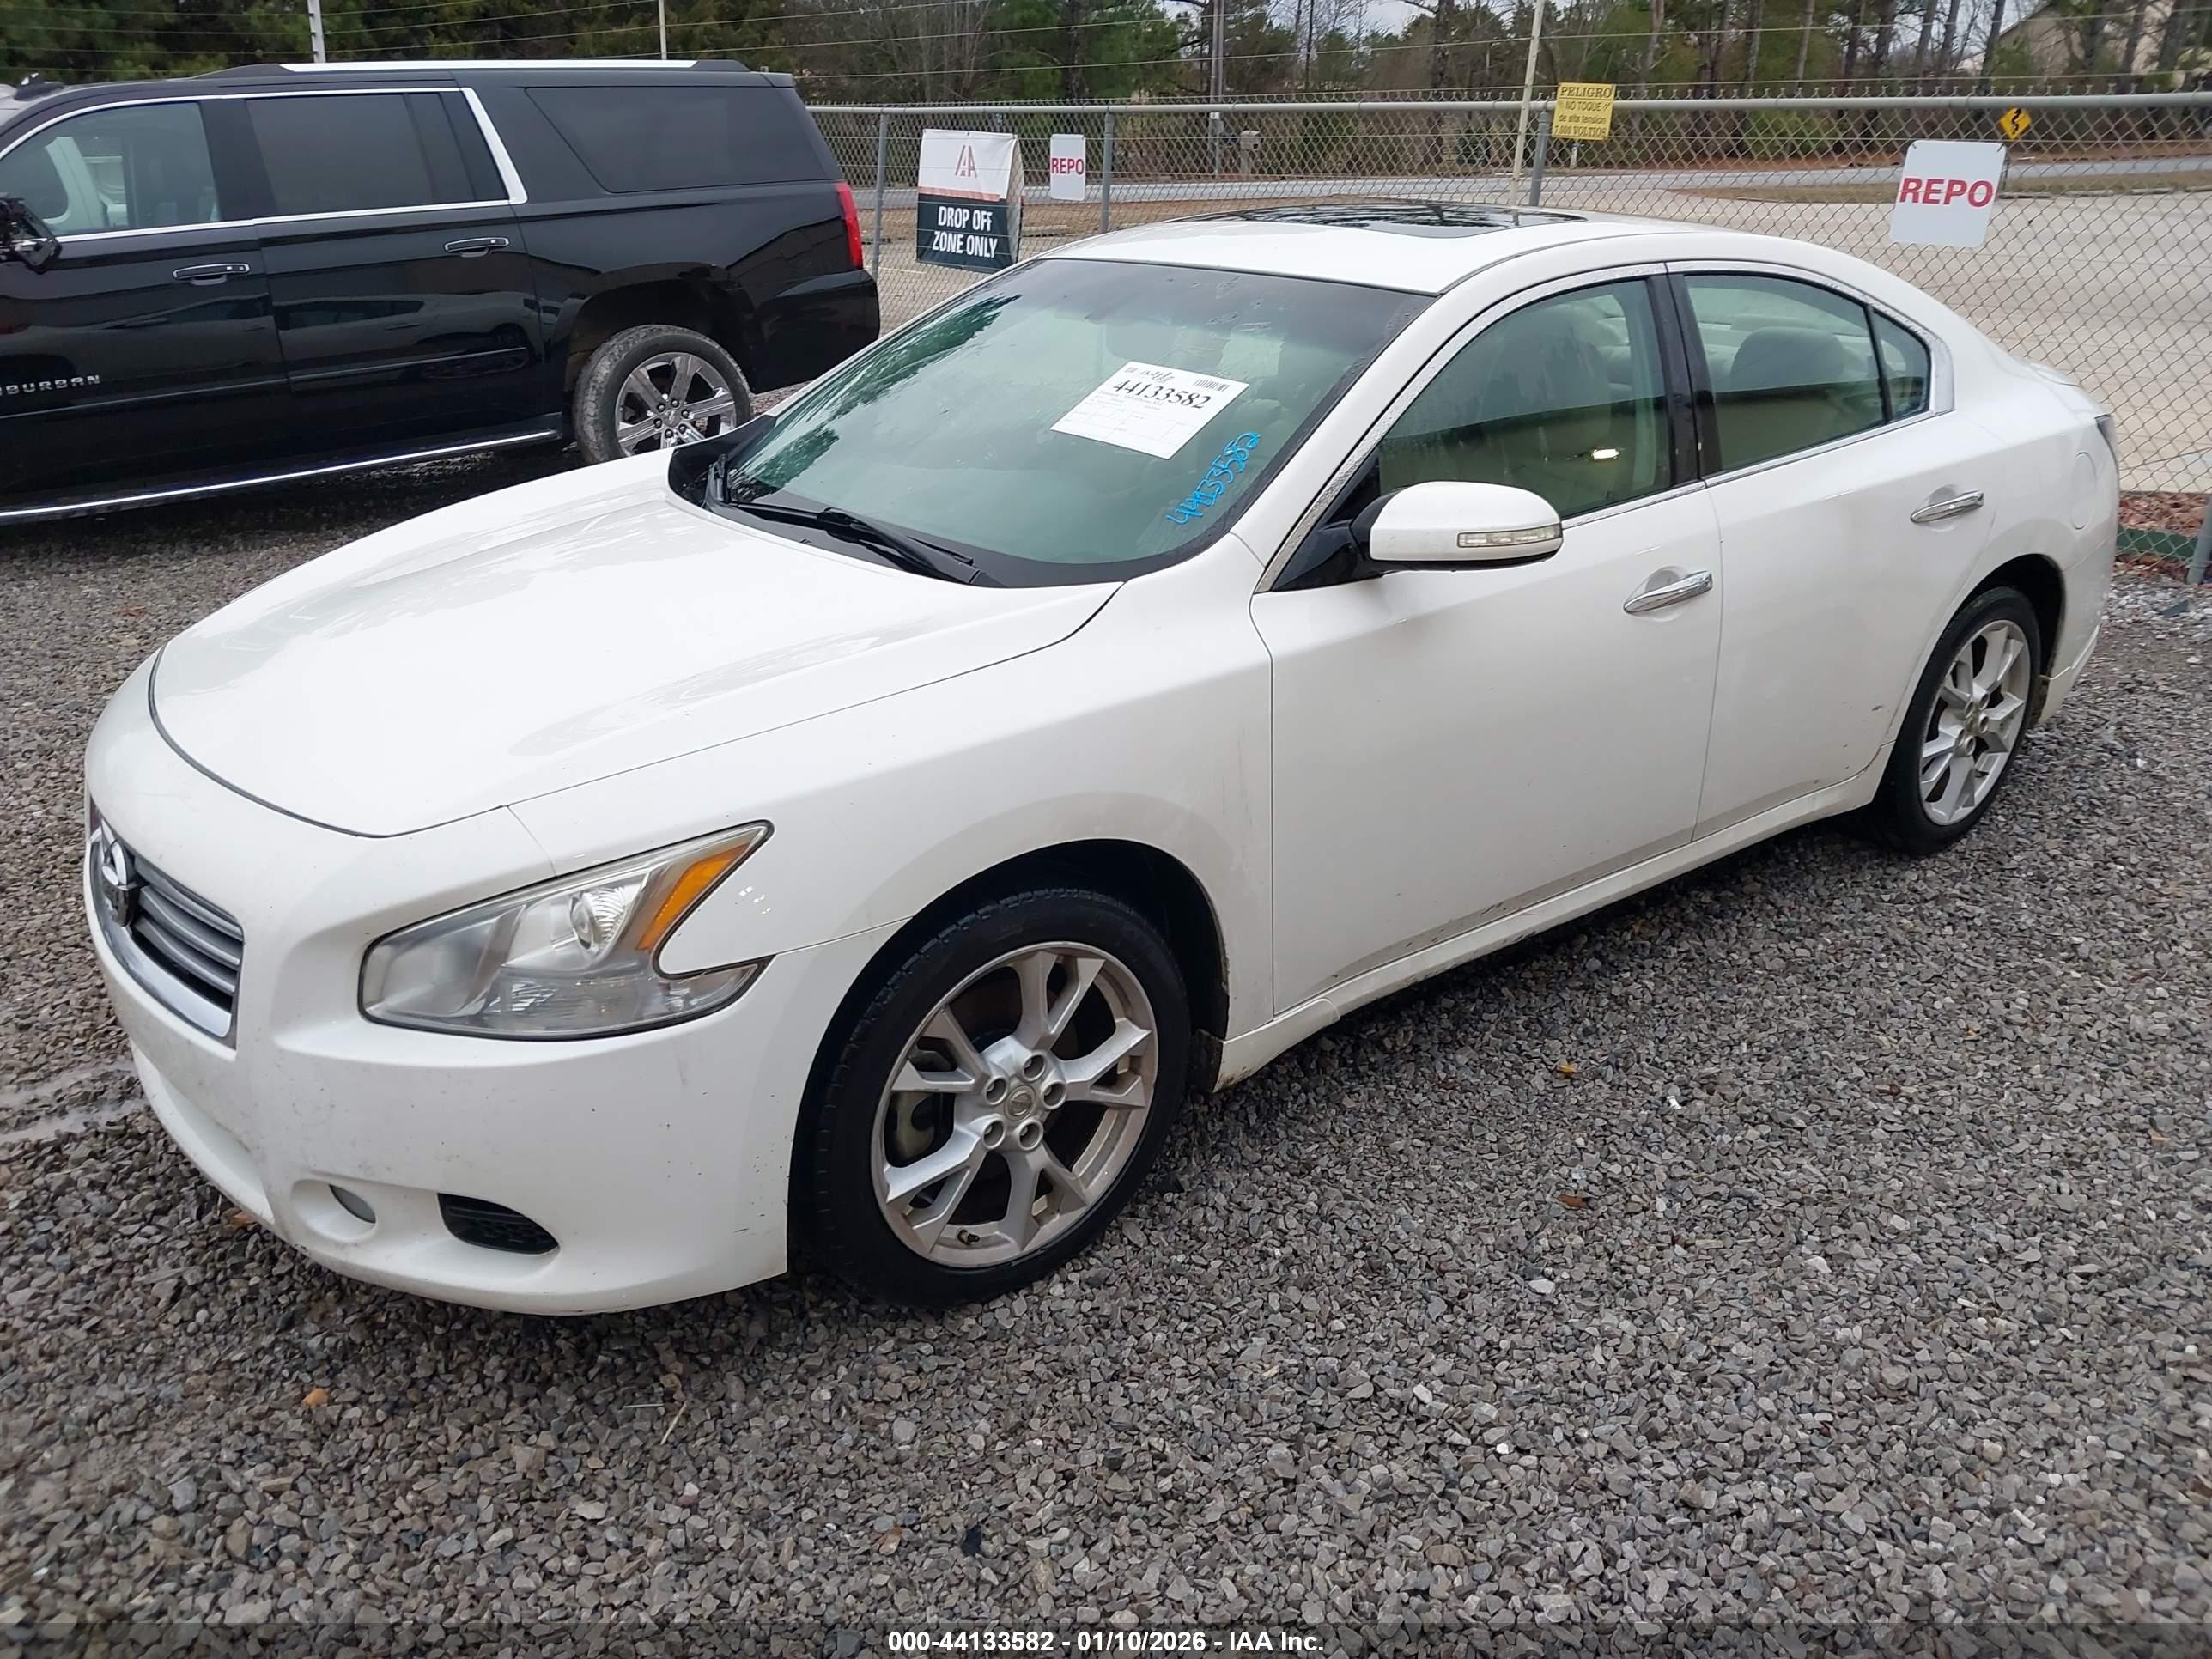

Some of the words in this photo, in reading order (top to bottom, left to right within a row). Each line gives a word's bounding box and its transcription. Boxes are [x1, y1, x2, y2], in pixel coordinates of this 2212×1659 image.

[1560, 87, 1612, 98] PELIGRO
[1565, 101, 1576, 111] NO
[1052, 157, 1084, 175] REPO
[1899, 178, 1993, 207] REPO
[938, 206, 969, 228] DROP
[972, 209, 994, 232] OFF
[933, 231, 963, 252] ZONE
[966, 234, 998, 258] ONLY
[0, 374, 100, 396] BURBAN
[1114, 379, 1212, 410] 44133582
